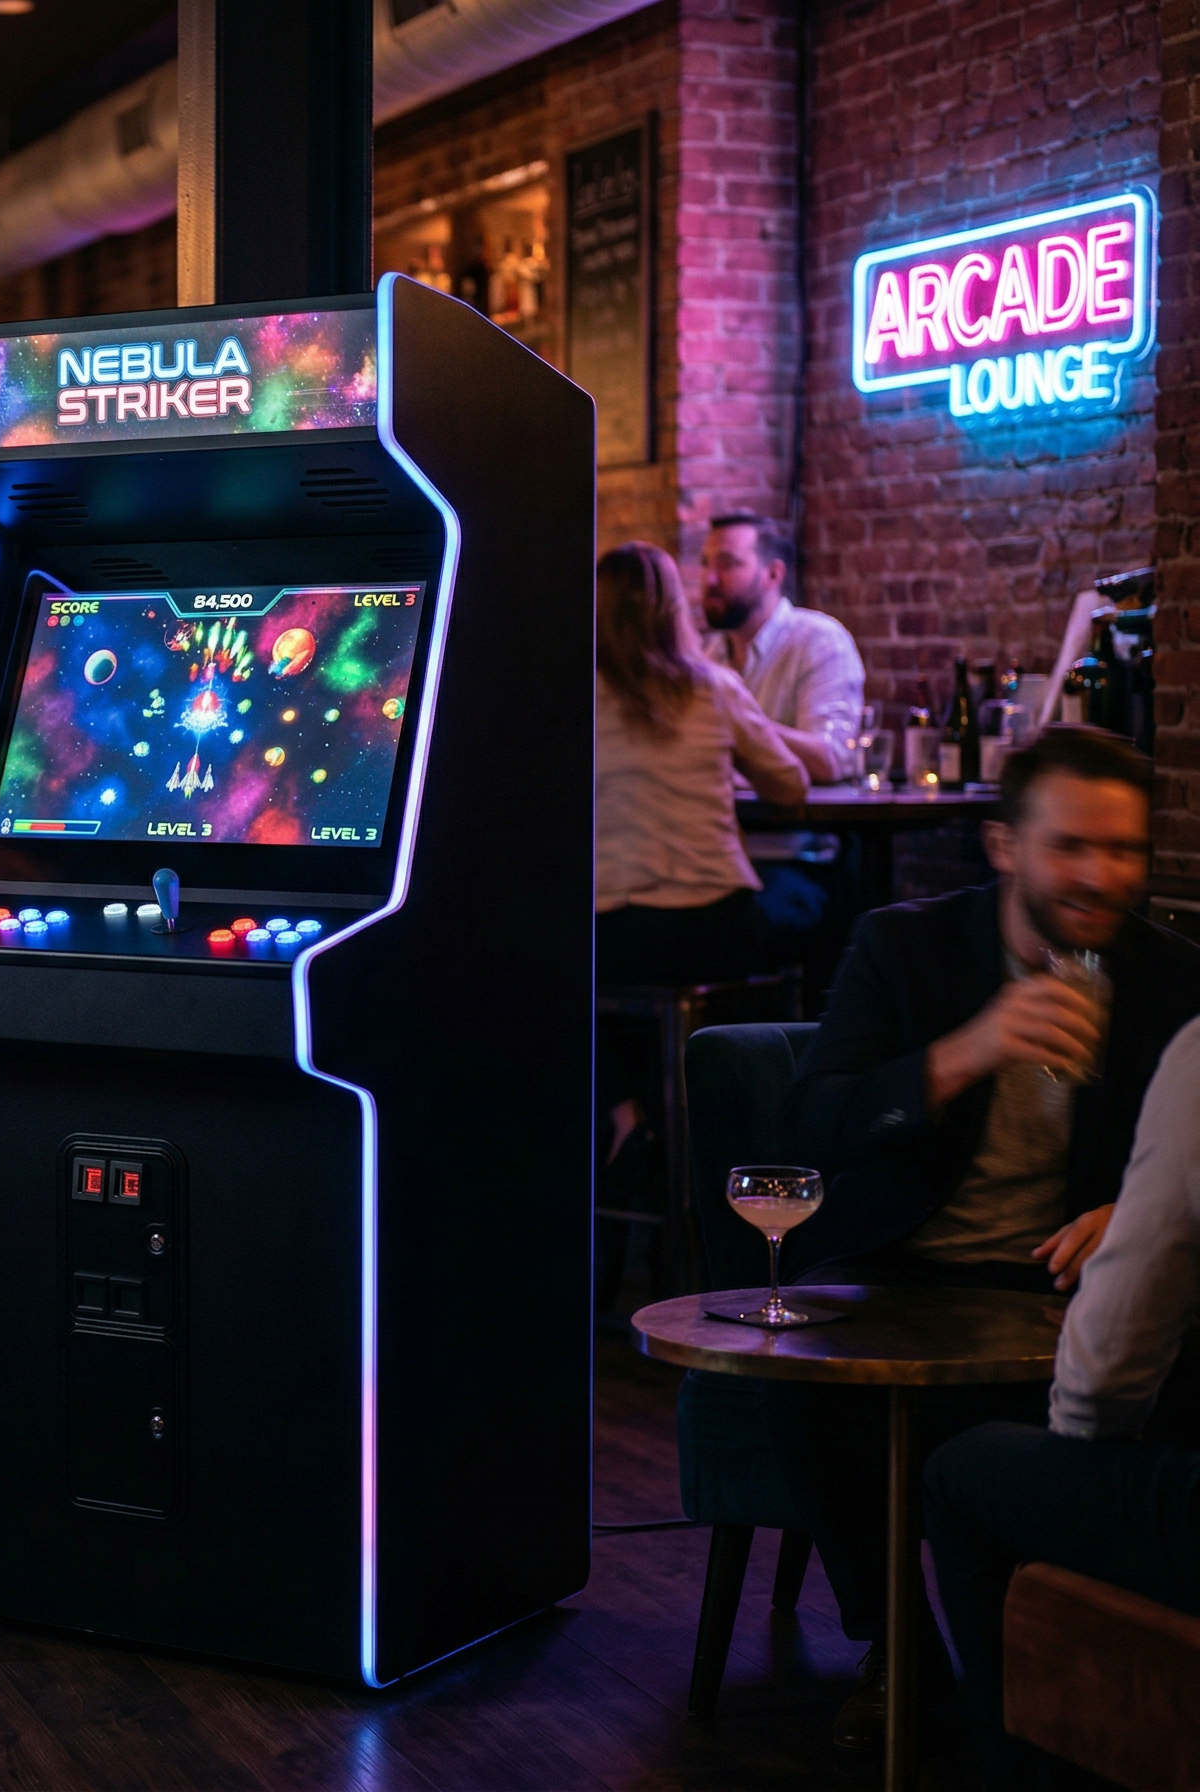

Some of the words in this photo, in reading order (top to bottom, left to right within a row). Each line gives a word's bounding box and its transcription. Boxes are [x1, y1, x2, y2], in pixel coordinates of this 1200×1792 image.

[864, 221, 1133, 364] ARCADE
[57, 336, 251, 388] NEBULA
[950, 339, 1114, 417] LOUNGE
[57, 376, 252, 425] STRIKER
[50, 601, 100, 614] SCORE
[193, 594, 253, 609] 84,500
[354, 593, 400, 607] LEVEL
[404, 593, 416, 606] 3
[147, 822, 197, 836] LEVEL
[201, 823, 212, 837] 3
[311, 827, 361, 840] LEVEL
[365, 828, 378, 841] 3
